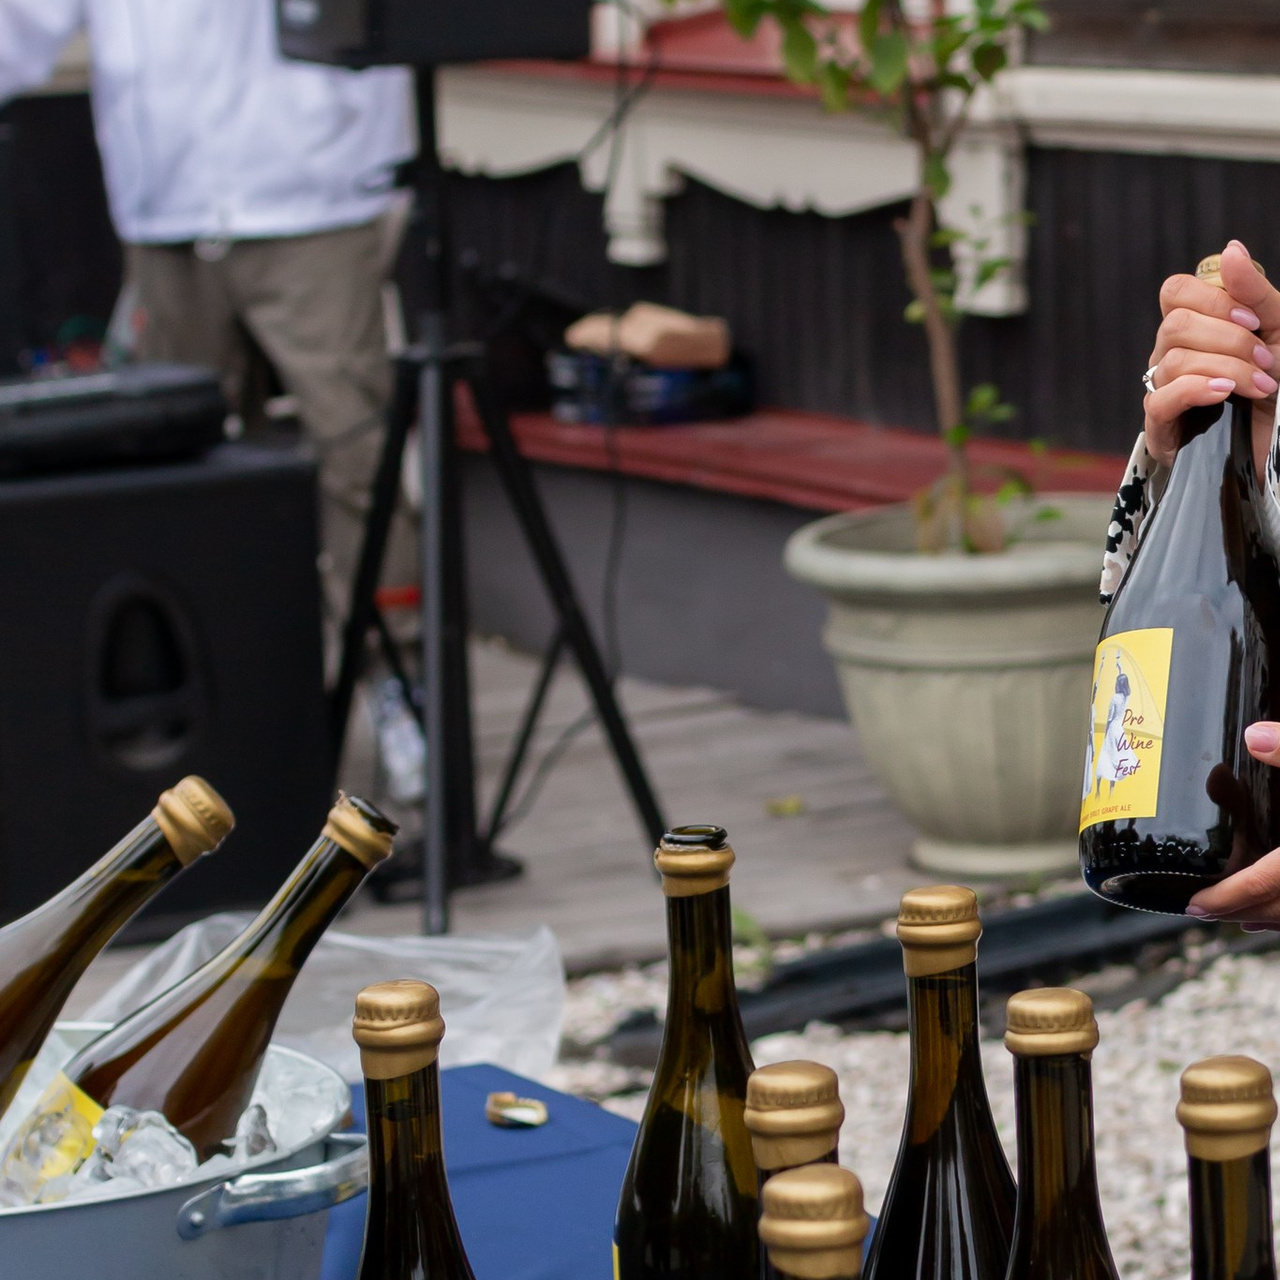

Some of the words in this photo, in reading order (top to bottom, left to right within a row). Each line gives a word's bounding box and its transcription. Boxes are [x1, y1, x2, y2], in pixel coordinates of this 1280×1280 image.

[1121, 708, 1144, 726] Pro
[1117, 732, 1154, 752] Wine
[1115, 758, 1141, 778] Fest
[1101, 805, 1119, 815] GRAPE
[1120, 804, 1132, 812] ALE
